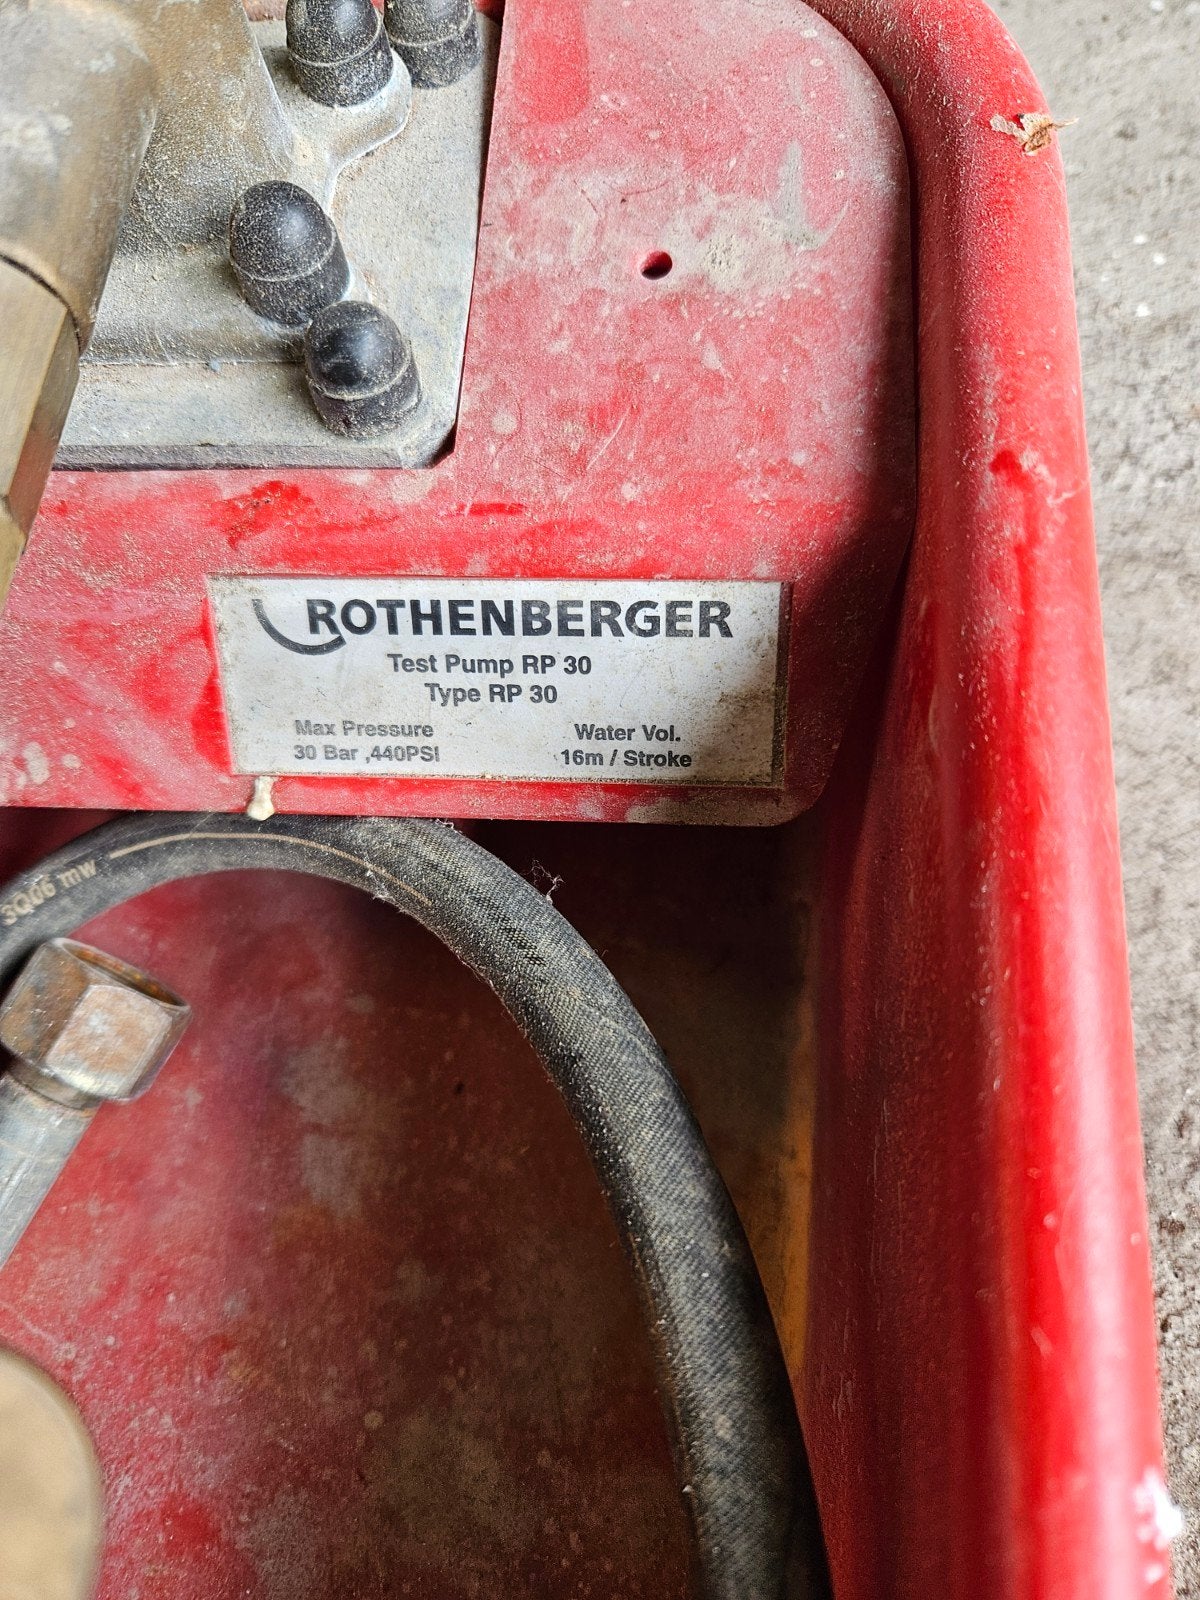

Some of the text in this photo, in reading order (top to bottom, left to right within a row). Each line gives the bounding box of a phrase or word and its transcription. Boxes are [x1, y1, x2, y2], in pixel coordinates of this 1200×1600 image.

[306, 599, 734, 638] ROTHENBERGER
[387, 654, 592, 679] Test Pump RP 30
[425, 683, 558, 706] Type RP 30
[295, 720, 434, 738] Max Pressure
[574, 723, 681, 742] Water Vol.
[294, 745, 441, 764] 30 Bar ,440PSI
[560, 749, 693, 768] 16m / Stroke
